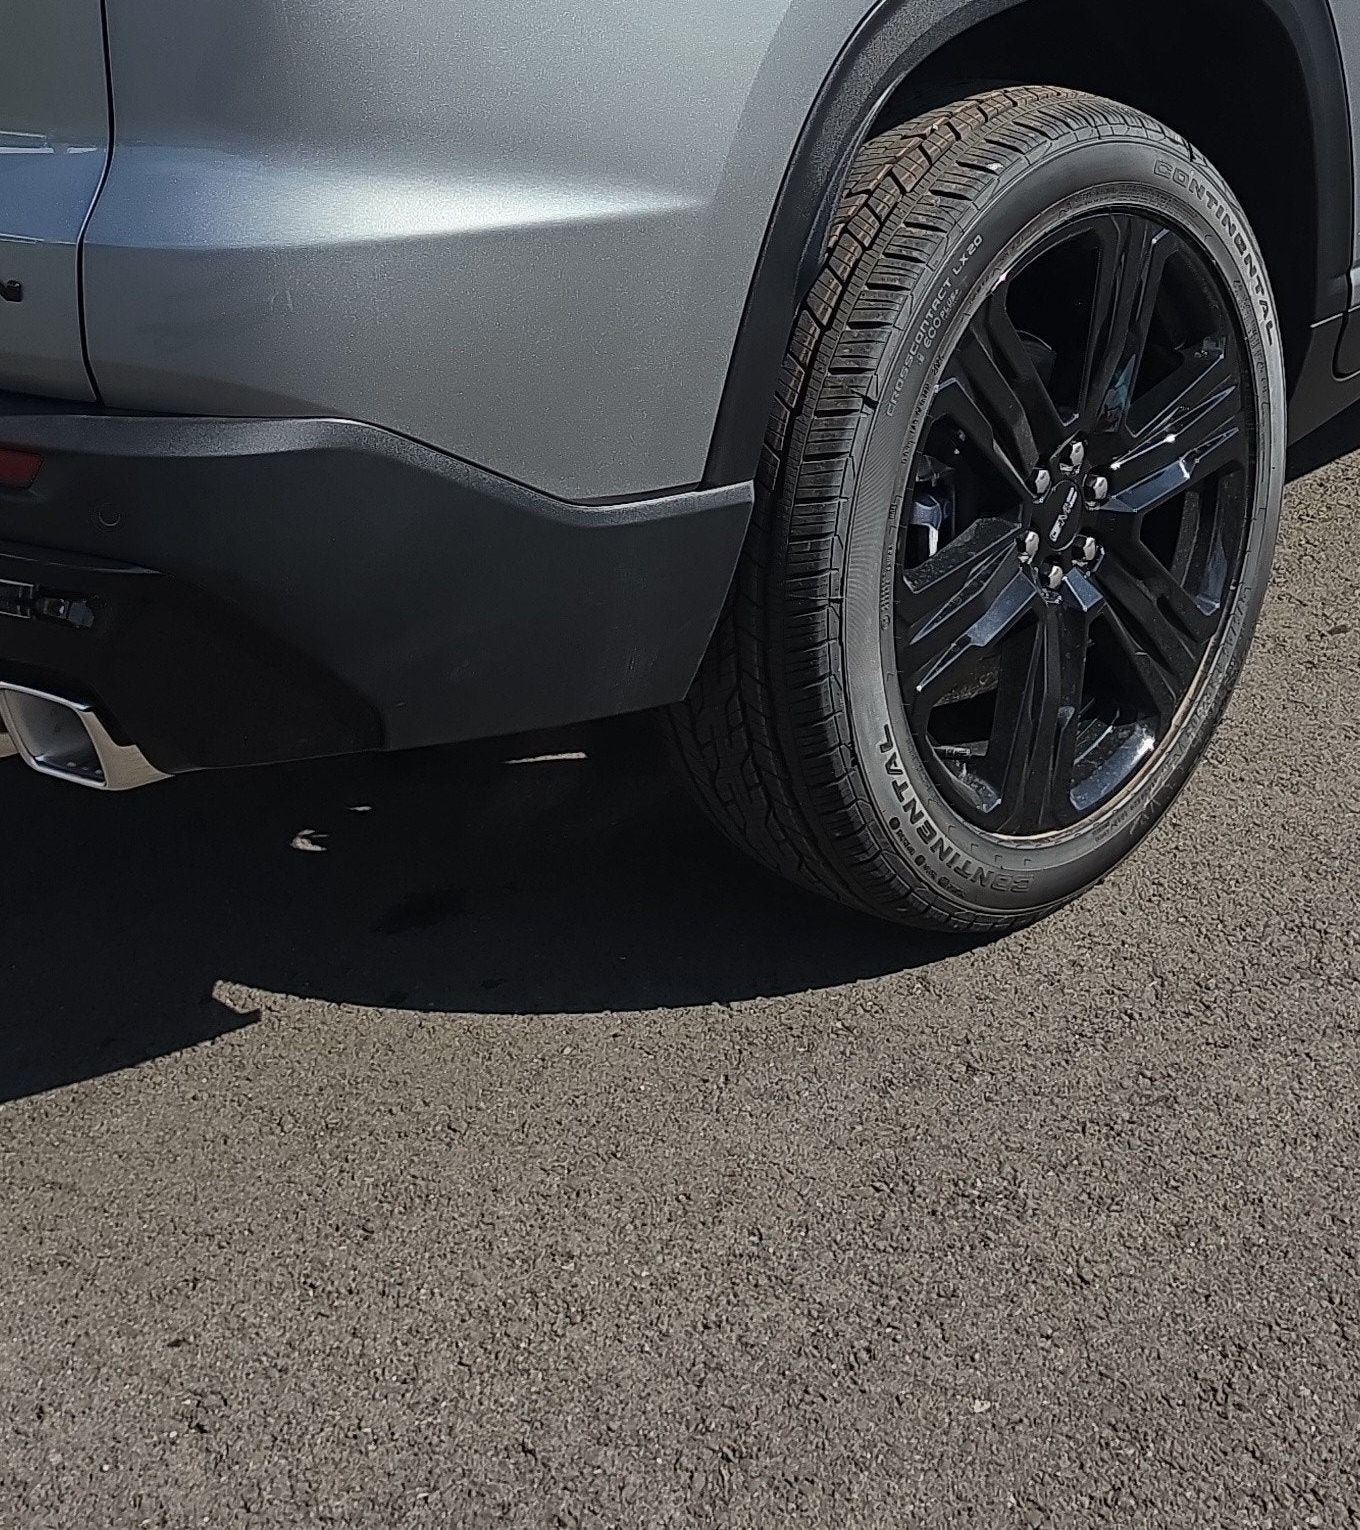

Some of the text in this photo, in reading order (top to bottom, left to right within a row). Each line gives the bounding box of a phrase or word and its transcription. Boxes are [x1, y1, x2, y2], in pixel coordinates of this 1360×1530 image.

[1153, 158, 1275, 347] CONTINENTAL
[886, 276, 954, 417] CROSSCONTACT
[878, 723, 1033, 894] CONTINENTAL
